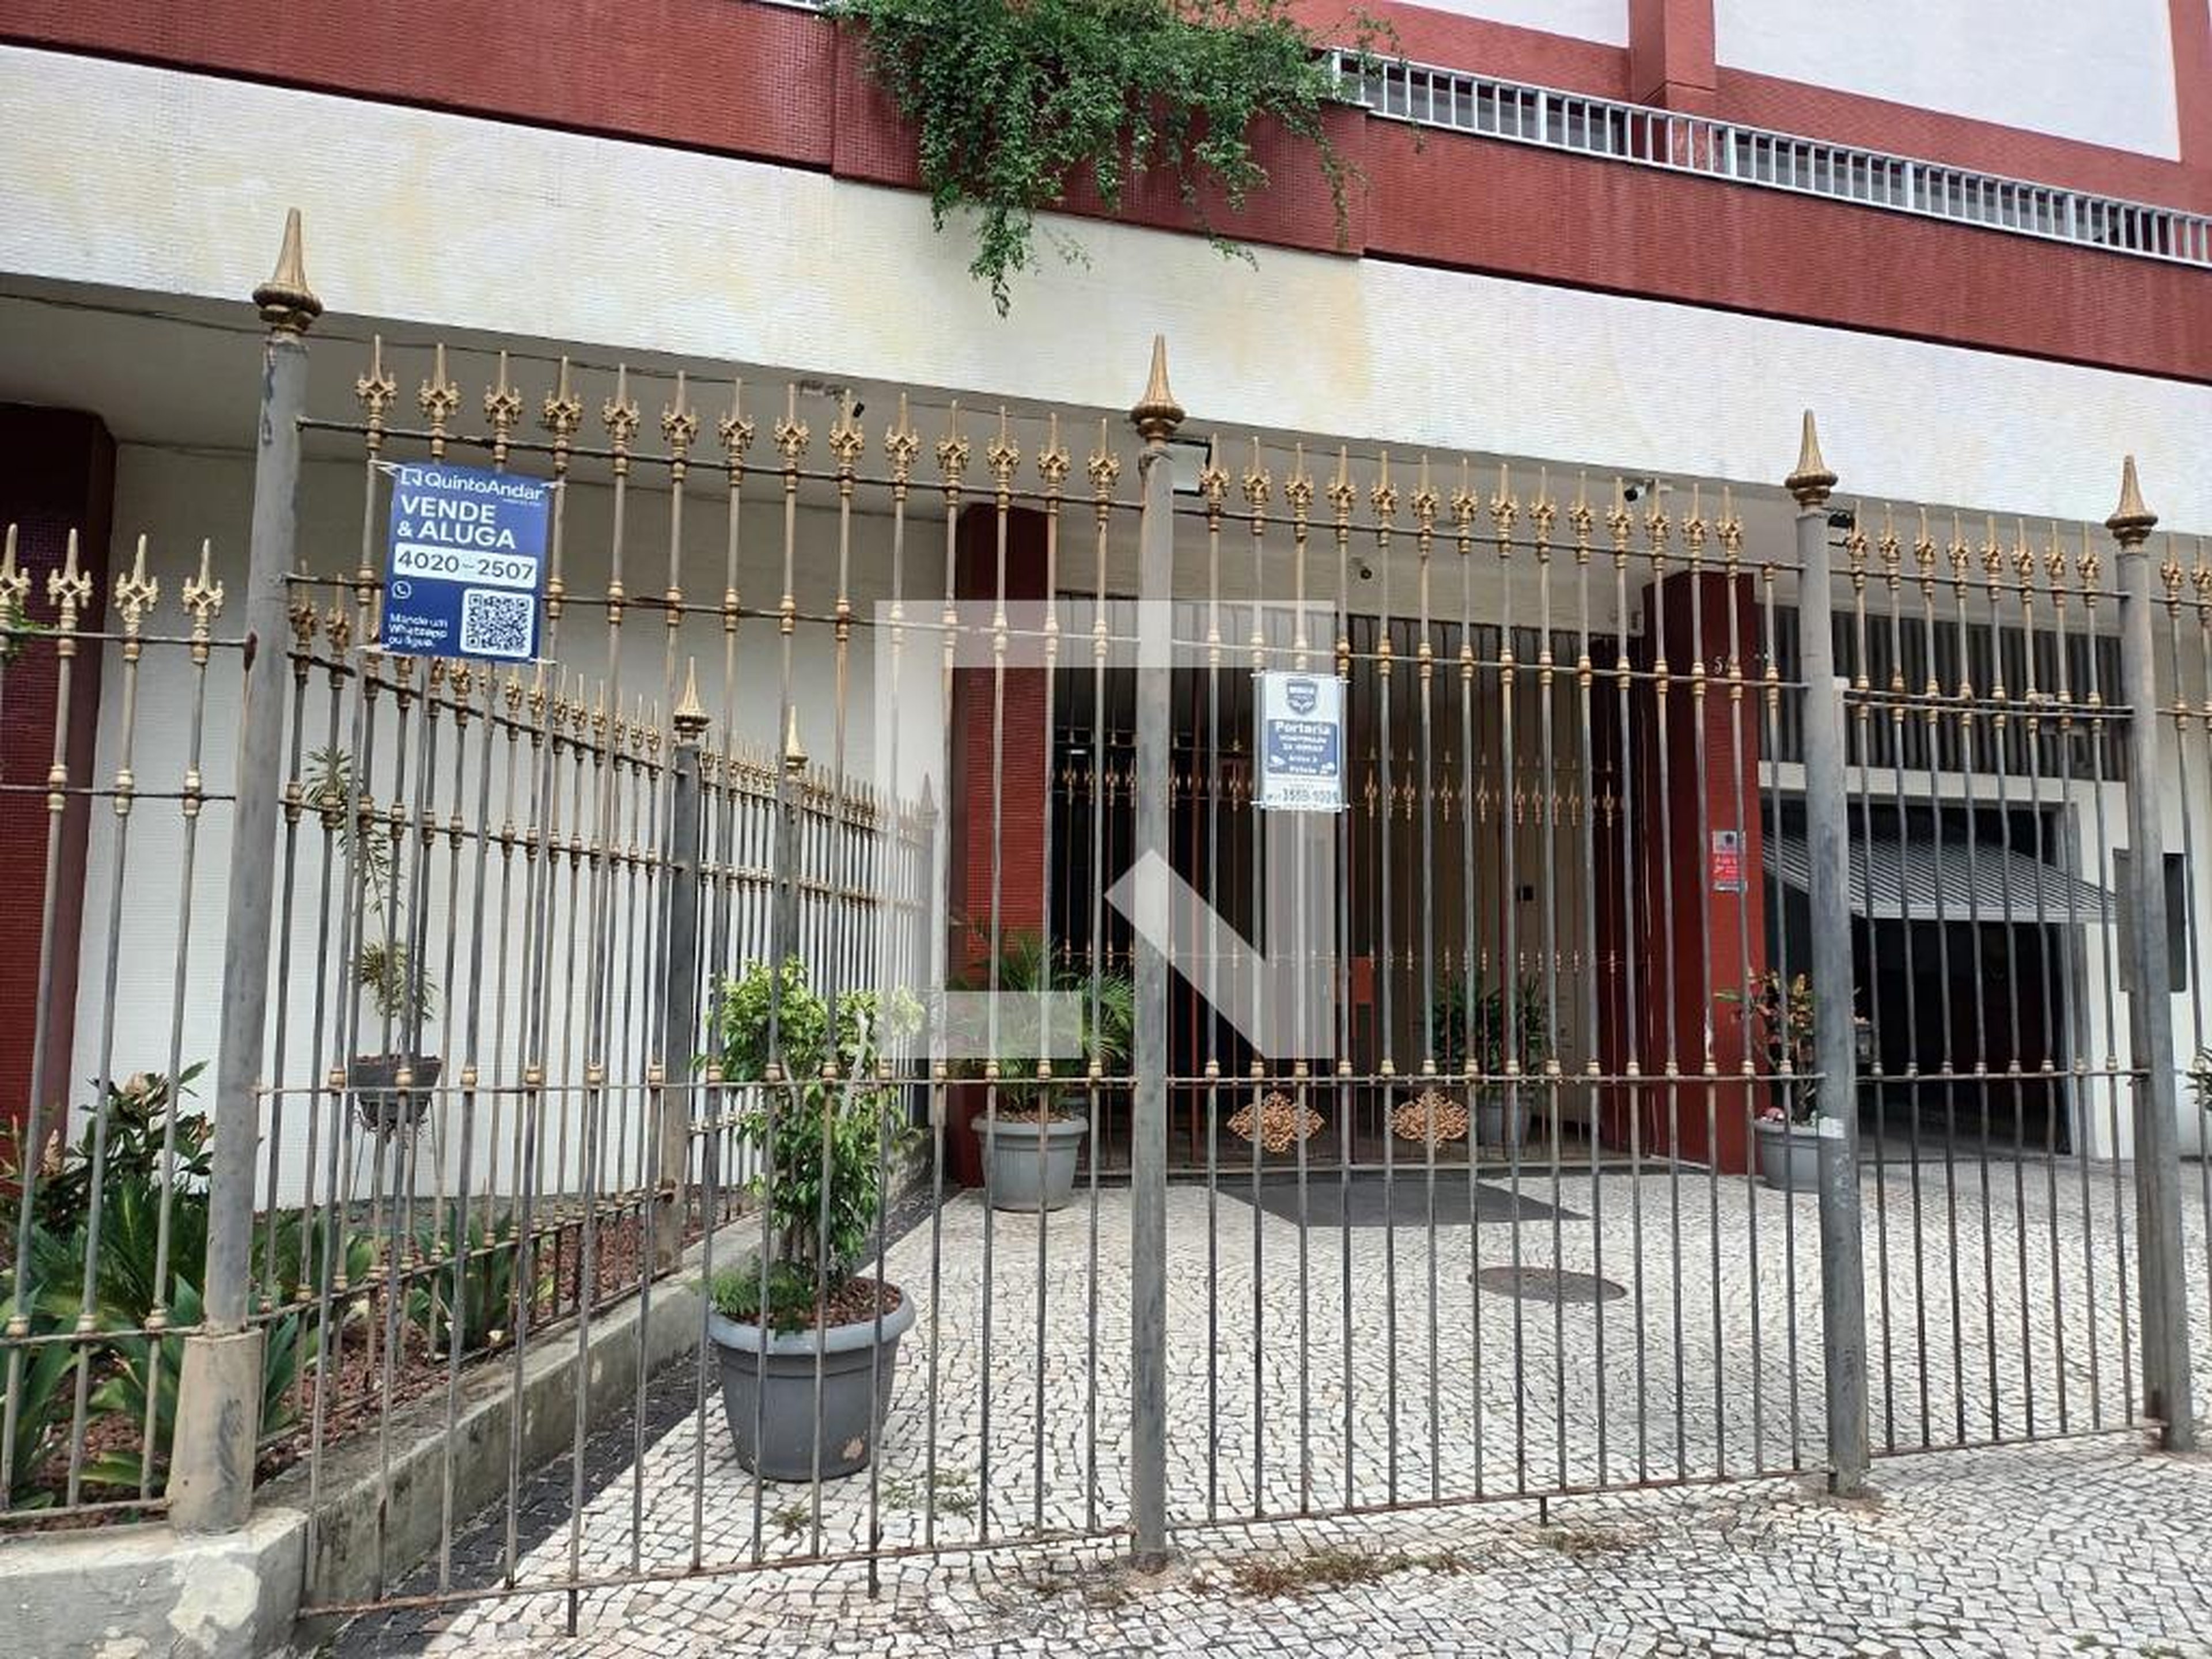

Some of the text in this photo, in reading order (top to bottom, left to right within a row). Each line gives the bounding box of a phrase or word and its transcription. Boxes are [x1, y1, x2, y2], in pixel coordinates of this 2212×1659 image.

[425, 472, 543, 500] QuintoAndar
[401, 494, 496, 524] VENDE
[397, 520, 516, 549] & ALUGA
[1275, 721, 1331, 736] Portaria
